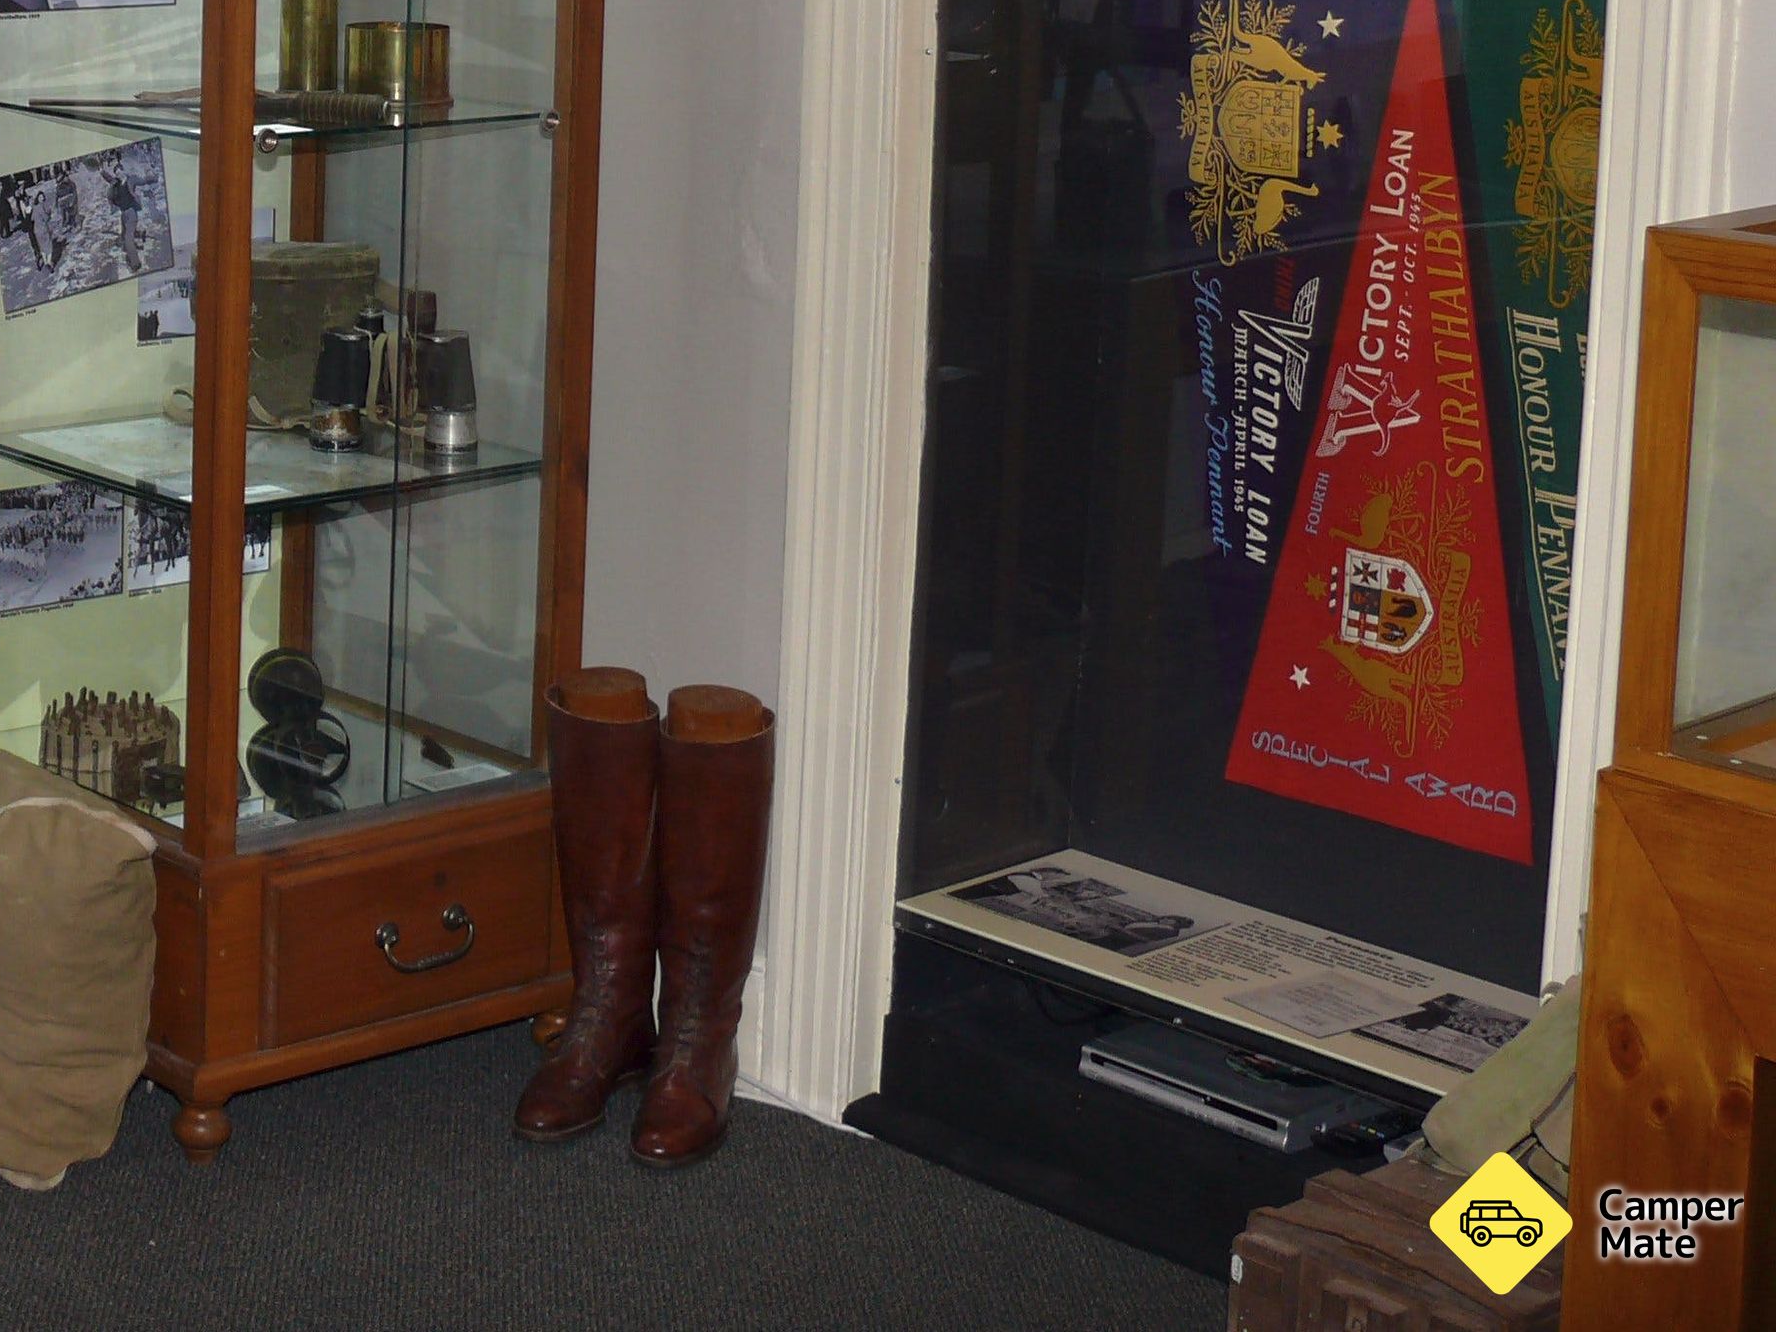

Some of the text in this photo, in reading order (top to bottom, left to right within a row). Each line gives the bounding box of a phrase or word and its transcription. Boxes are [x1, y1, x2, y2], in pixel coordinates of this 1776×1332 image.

[1408, 193, 1421, 232] 1945
[1334, 129, 1421, 444] VICTORY LOAN
[1403, 243, 1417, 283] OCT.
[1395, 302, 1412, 362] SEPT.
[1418, 171, 1485, 483] STRATHALBYN
[1192, 270, 1232, 557] Honour Pennant
[1513, 309, 1561, 473] HONOUR
[1238, 309, 1313, 564] VICTORY LOAN
[1234, 479, 1244, 512] 1945
[1305, 472, 1330, 535] FOURTH
[1251, 730, 1518, 817] SPECIAL AWARD
